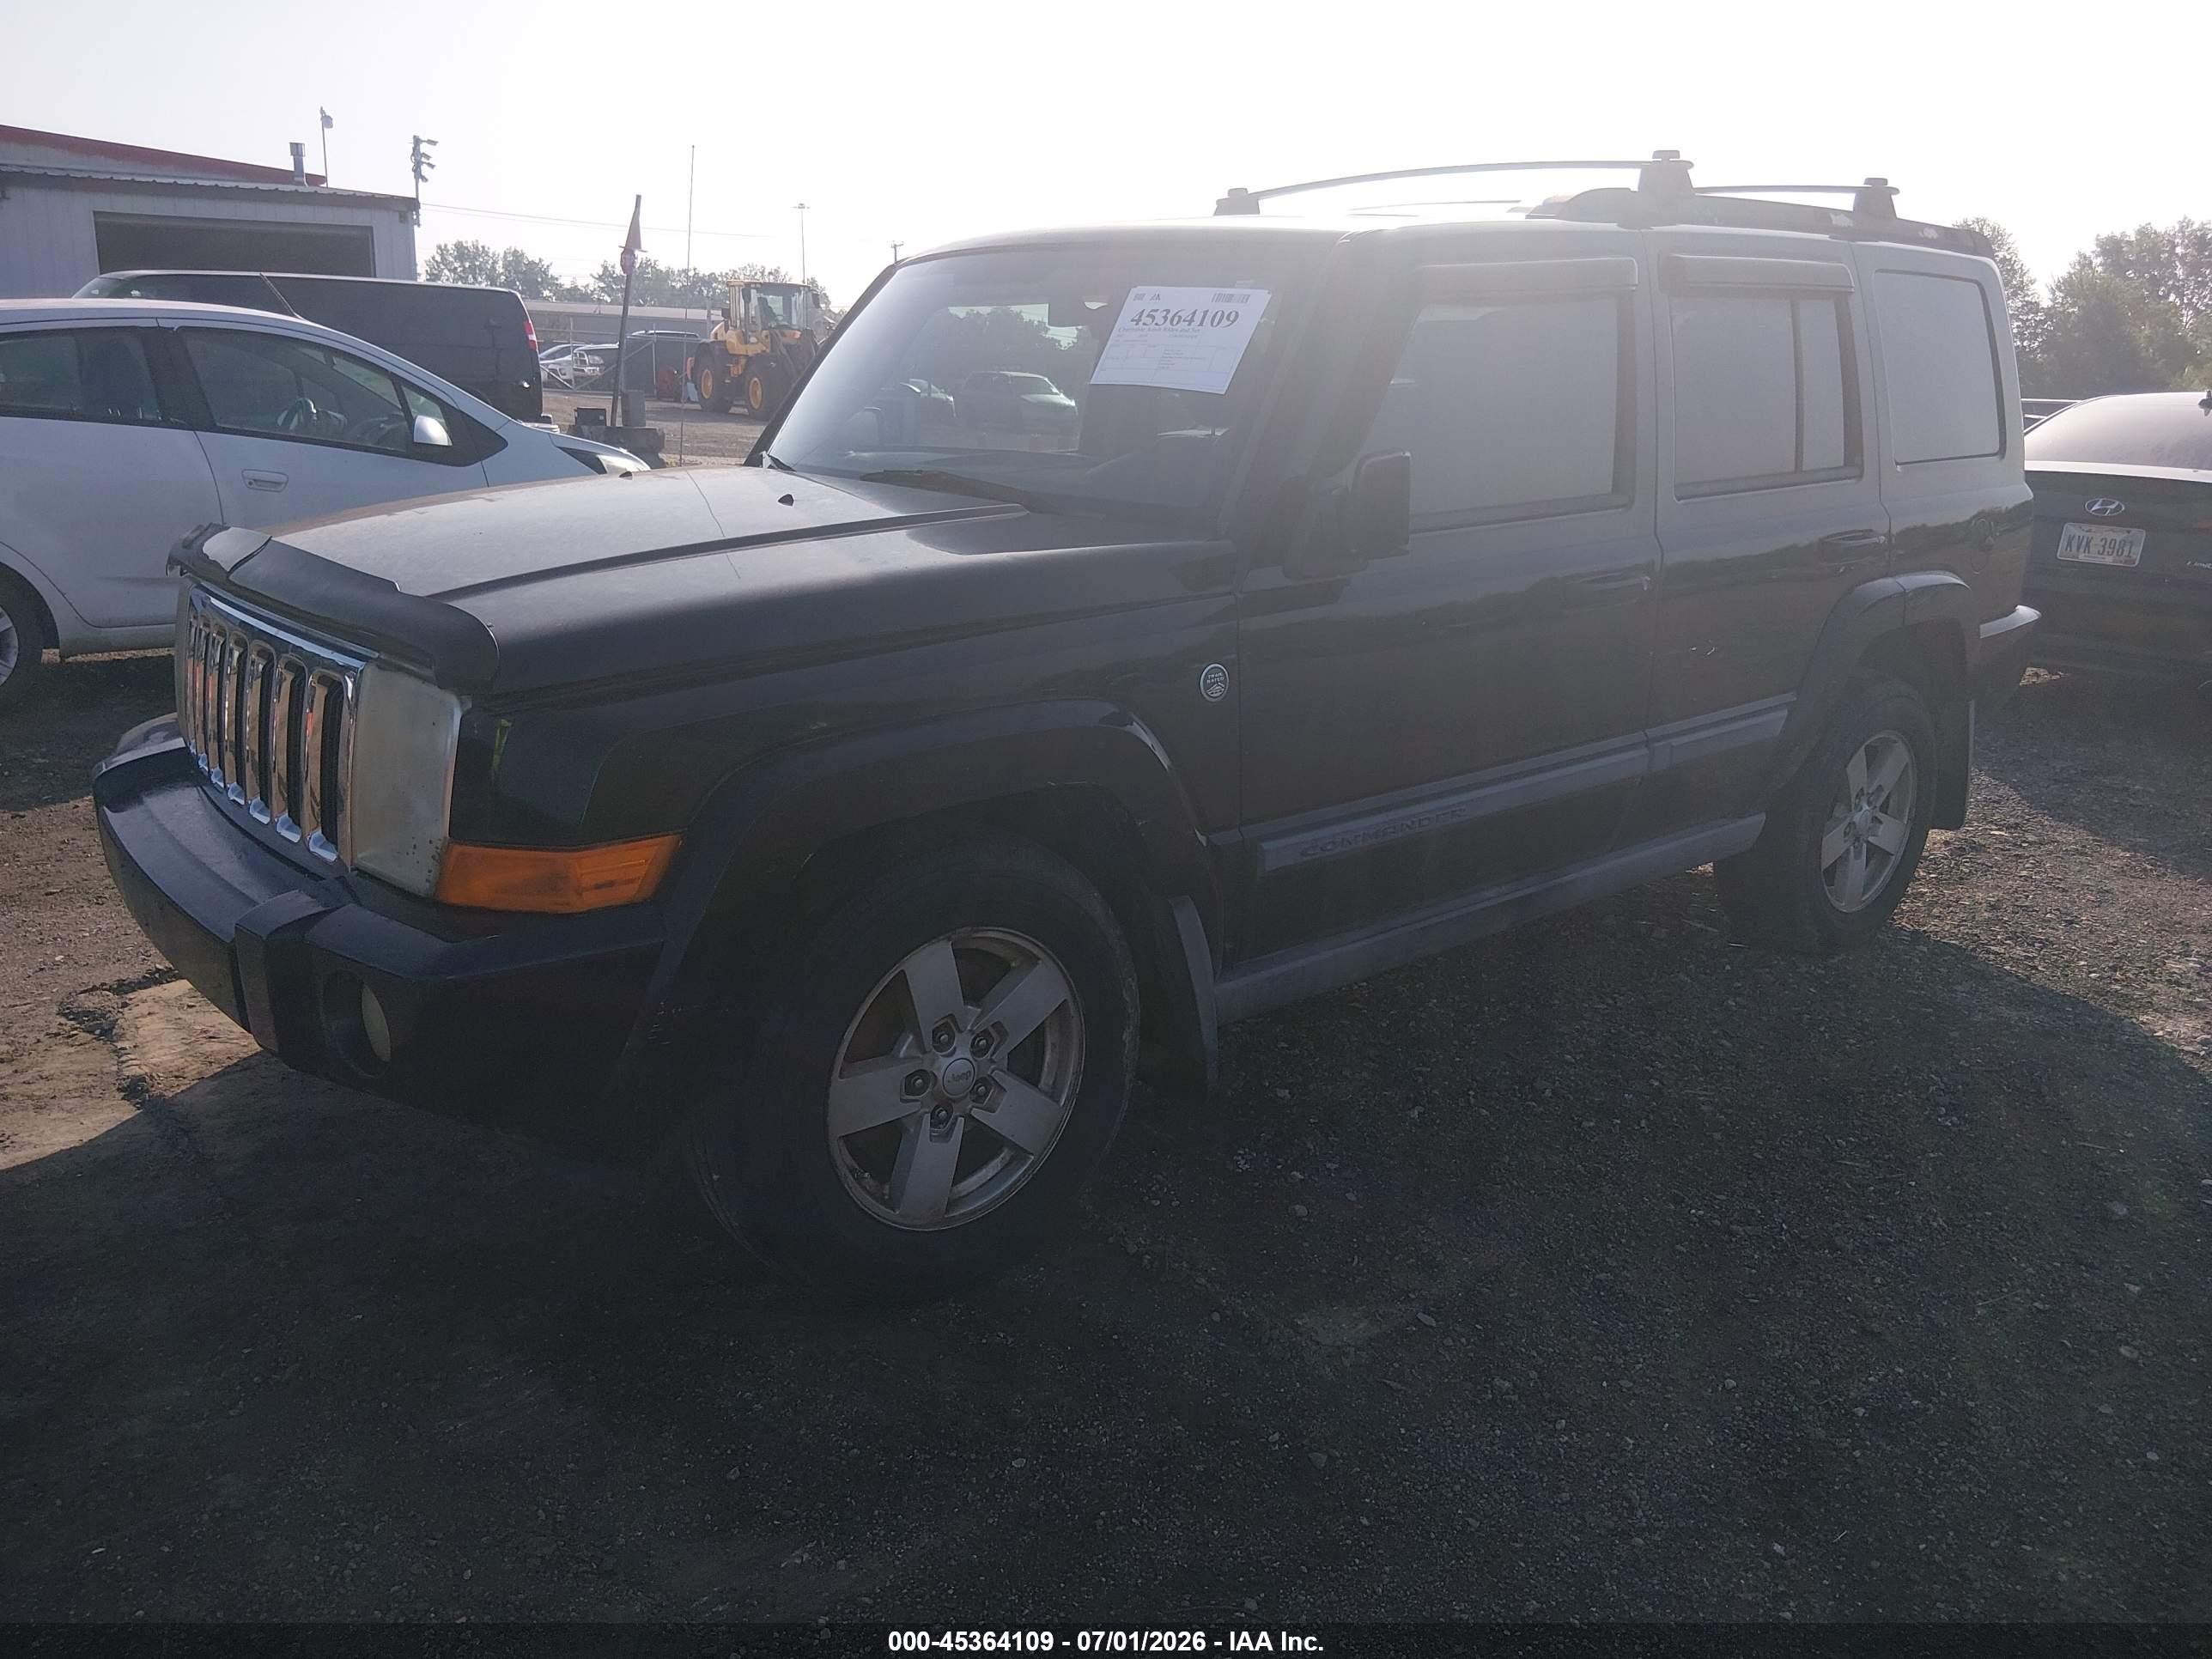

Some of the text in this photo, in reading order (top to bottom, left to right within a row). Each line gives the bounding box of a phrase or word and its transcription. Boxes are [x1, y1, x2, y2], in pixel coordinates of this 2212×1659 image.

[1130, 308, 1240, 328] 45364109
[2065, 534, 2134, 558] KVK 3981
[1300, 807, 1468, 857] COMMANDER
